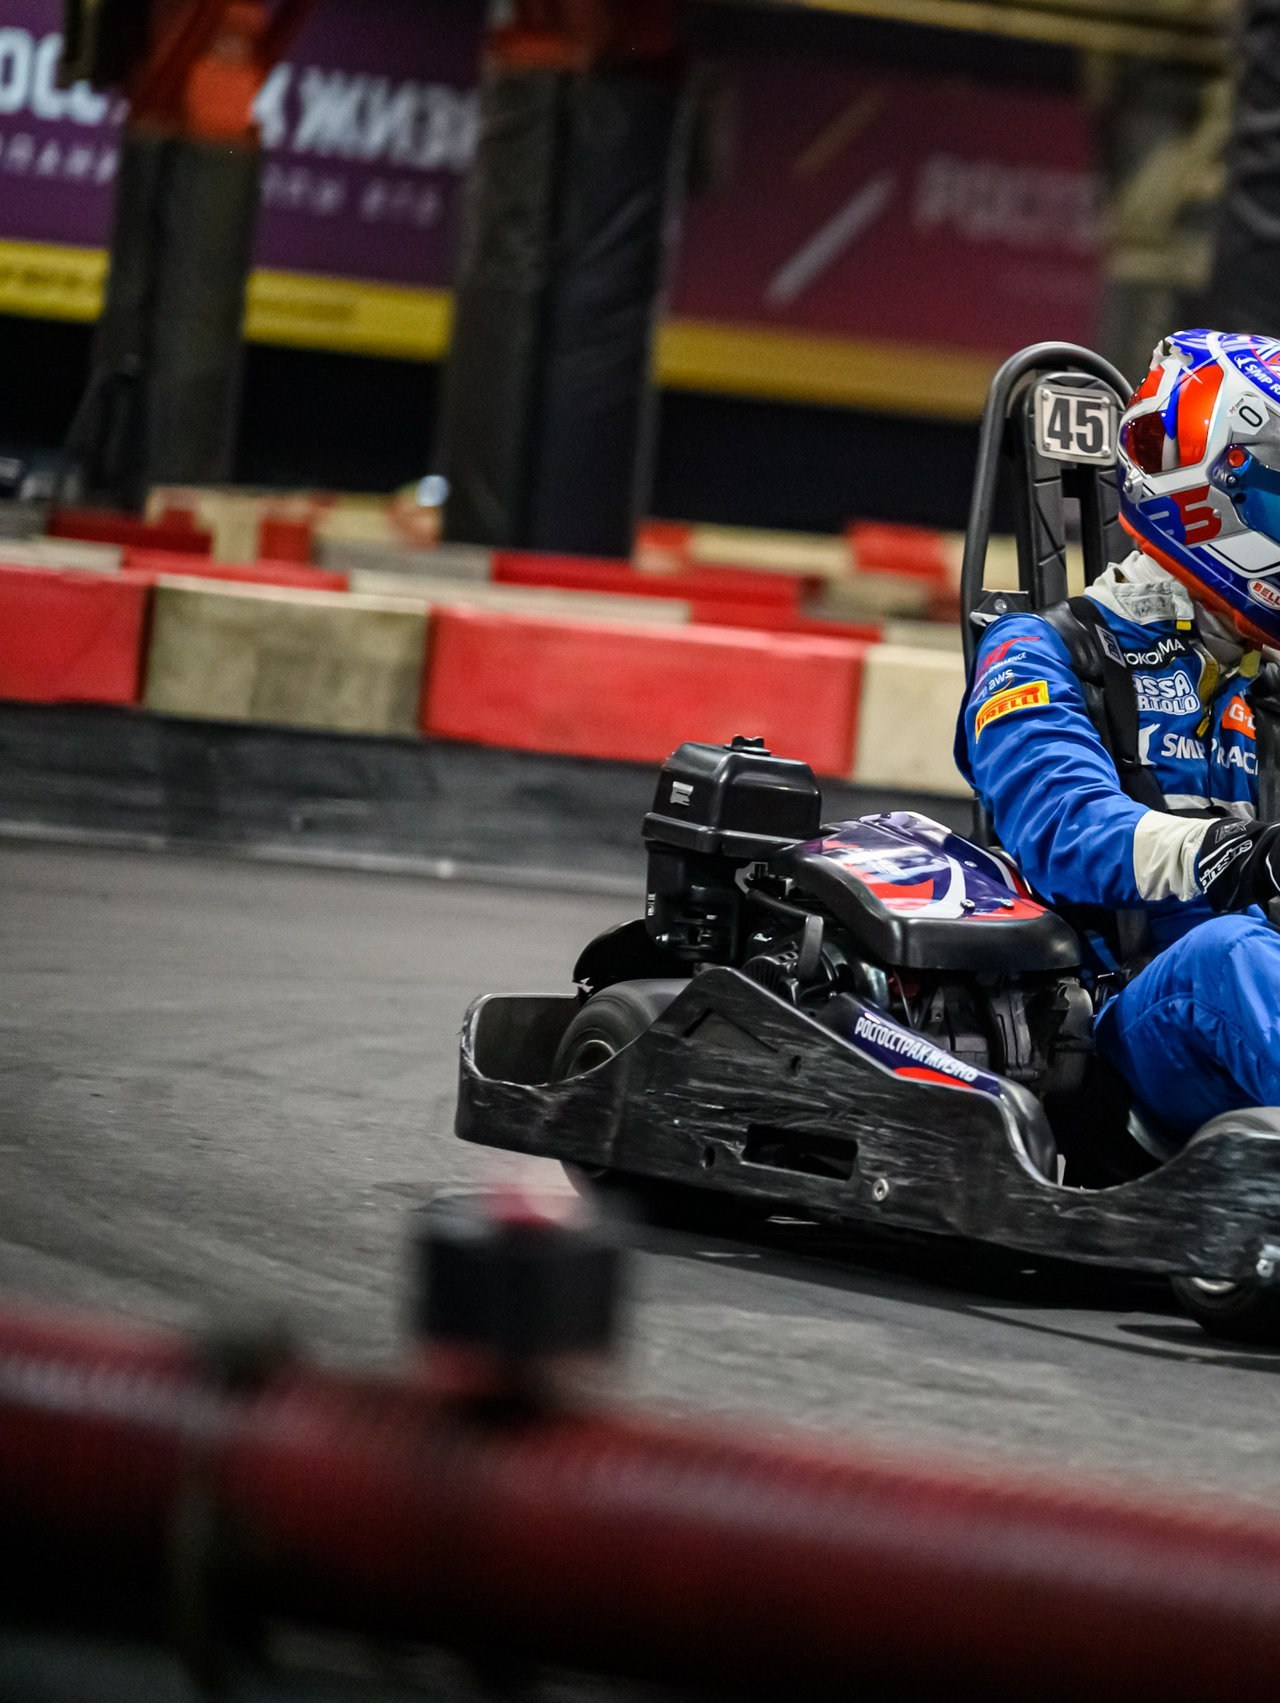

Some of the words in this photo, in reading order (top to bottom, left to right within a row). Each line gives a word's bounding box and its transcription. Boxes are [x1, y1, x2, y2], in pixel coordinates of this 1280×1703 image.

[1244, 364, 1273, 384] SMP
[1047, 397, 1104, 453] 45
[1253, 582, 1280, 606] BELL
[988, 669, 1014, 692] aws
[976, 685, 1041, 733] PIRELLI
